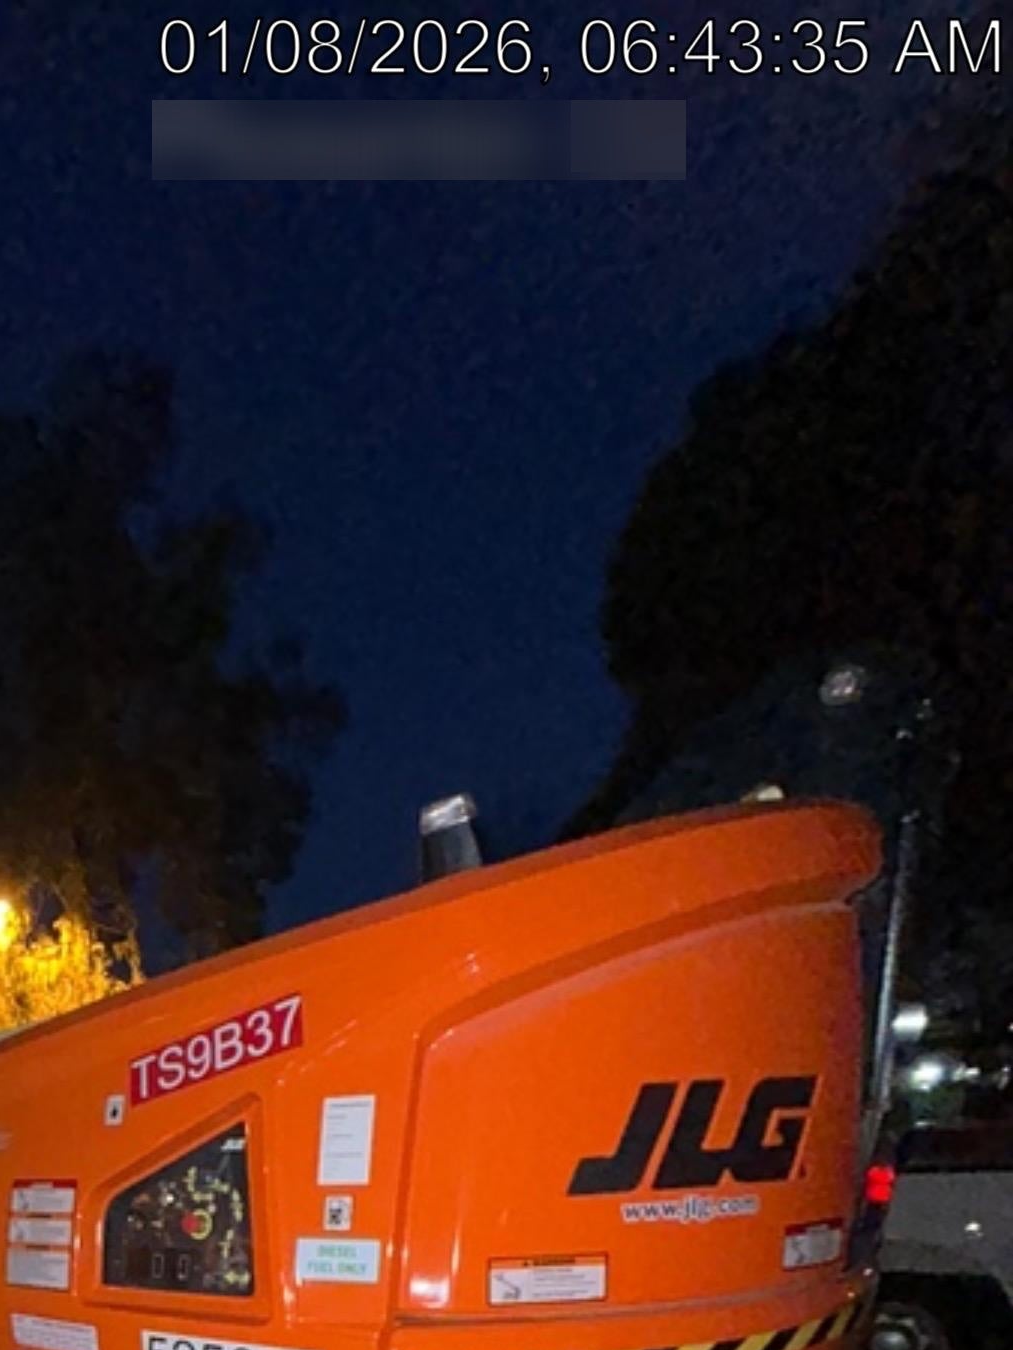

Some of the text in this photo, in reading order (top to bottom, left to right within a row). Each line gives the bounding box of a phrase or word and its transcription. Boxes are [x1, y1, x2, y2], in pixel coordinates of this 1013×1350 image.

[131, 996, 302, 1099] TS9B37
[567, 1075, 817, 1196] JLG
[622, 1196, 759, 1221] www.jlg.com
